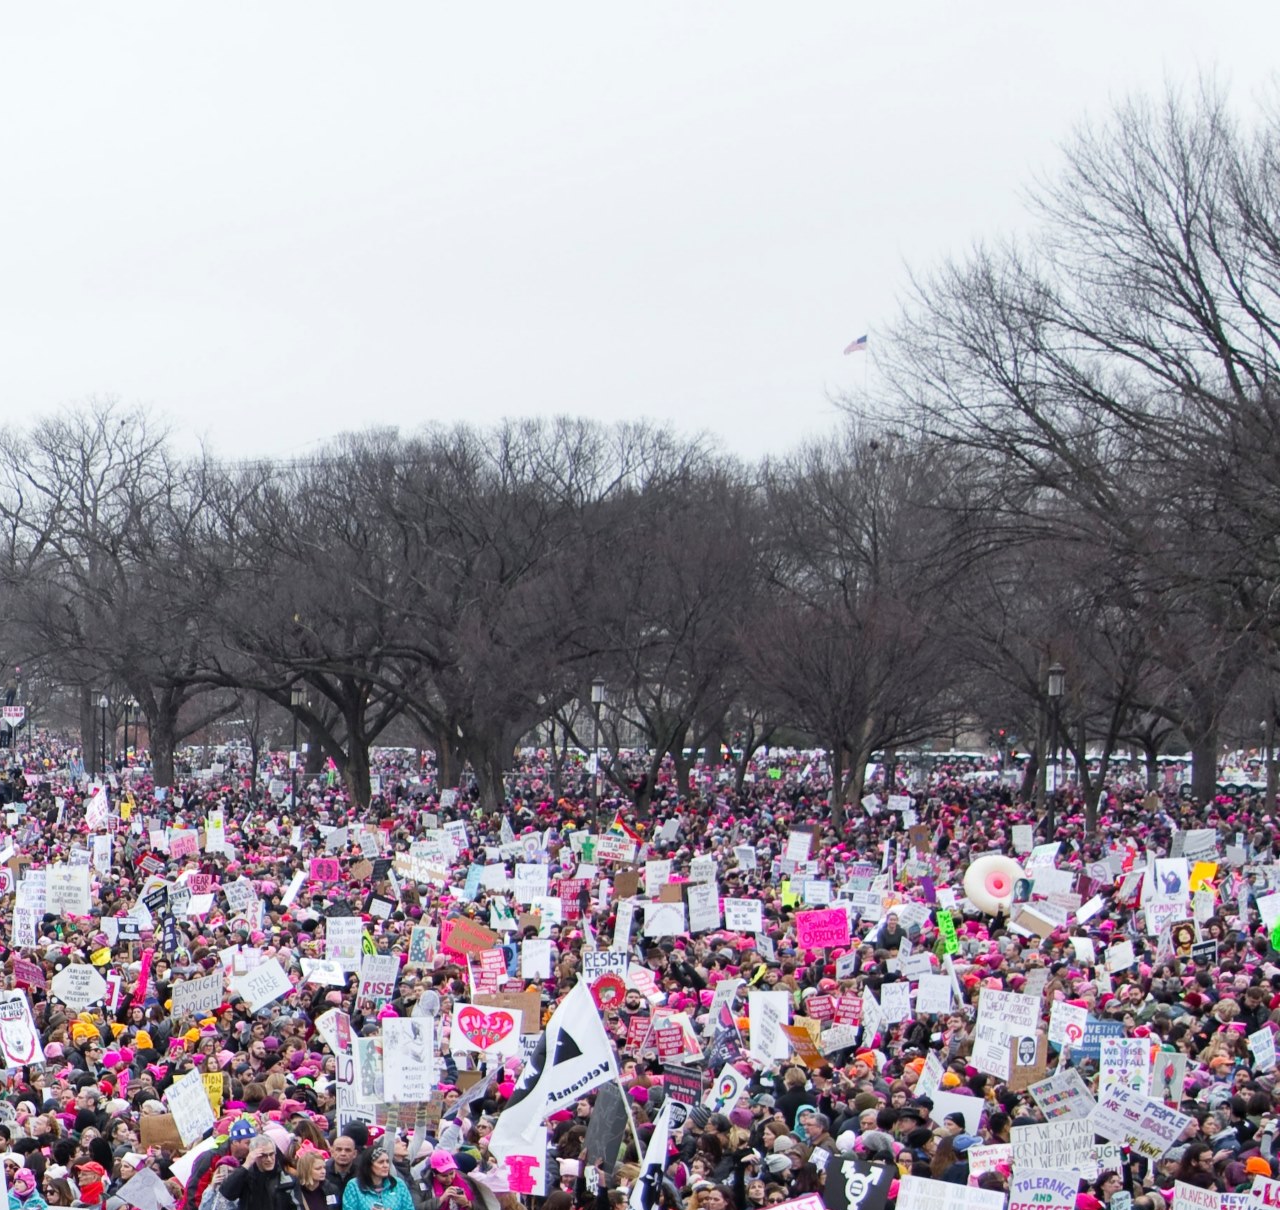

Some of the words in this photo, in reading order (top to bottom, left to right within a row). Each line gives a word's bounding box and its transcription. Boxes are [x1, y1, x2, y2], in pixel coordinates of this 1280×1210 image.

[190, 876, 210, 885] HEAR
[193, 885, 207, 893] OUR
[585, 952, 626, 968] RESIST
[174, 975, 219, 996] ENOUGH
[248, 971, 276, 991] STILL
[260, 980, 281, 997] RISE
[363, 981, 394, 995] RISE
[173, 994, 219, 1017] ENOUGH
[459, 1015, 512, 1032] PUSSY
[1015, 1178, 1075, 1199] TOLERANCE
[1032, 1193, 1053, 1202] AND
